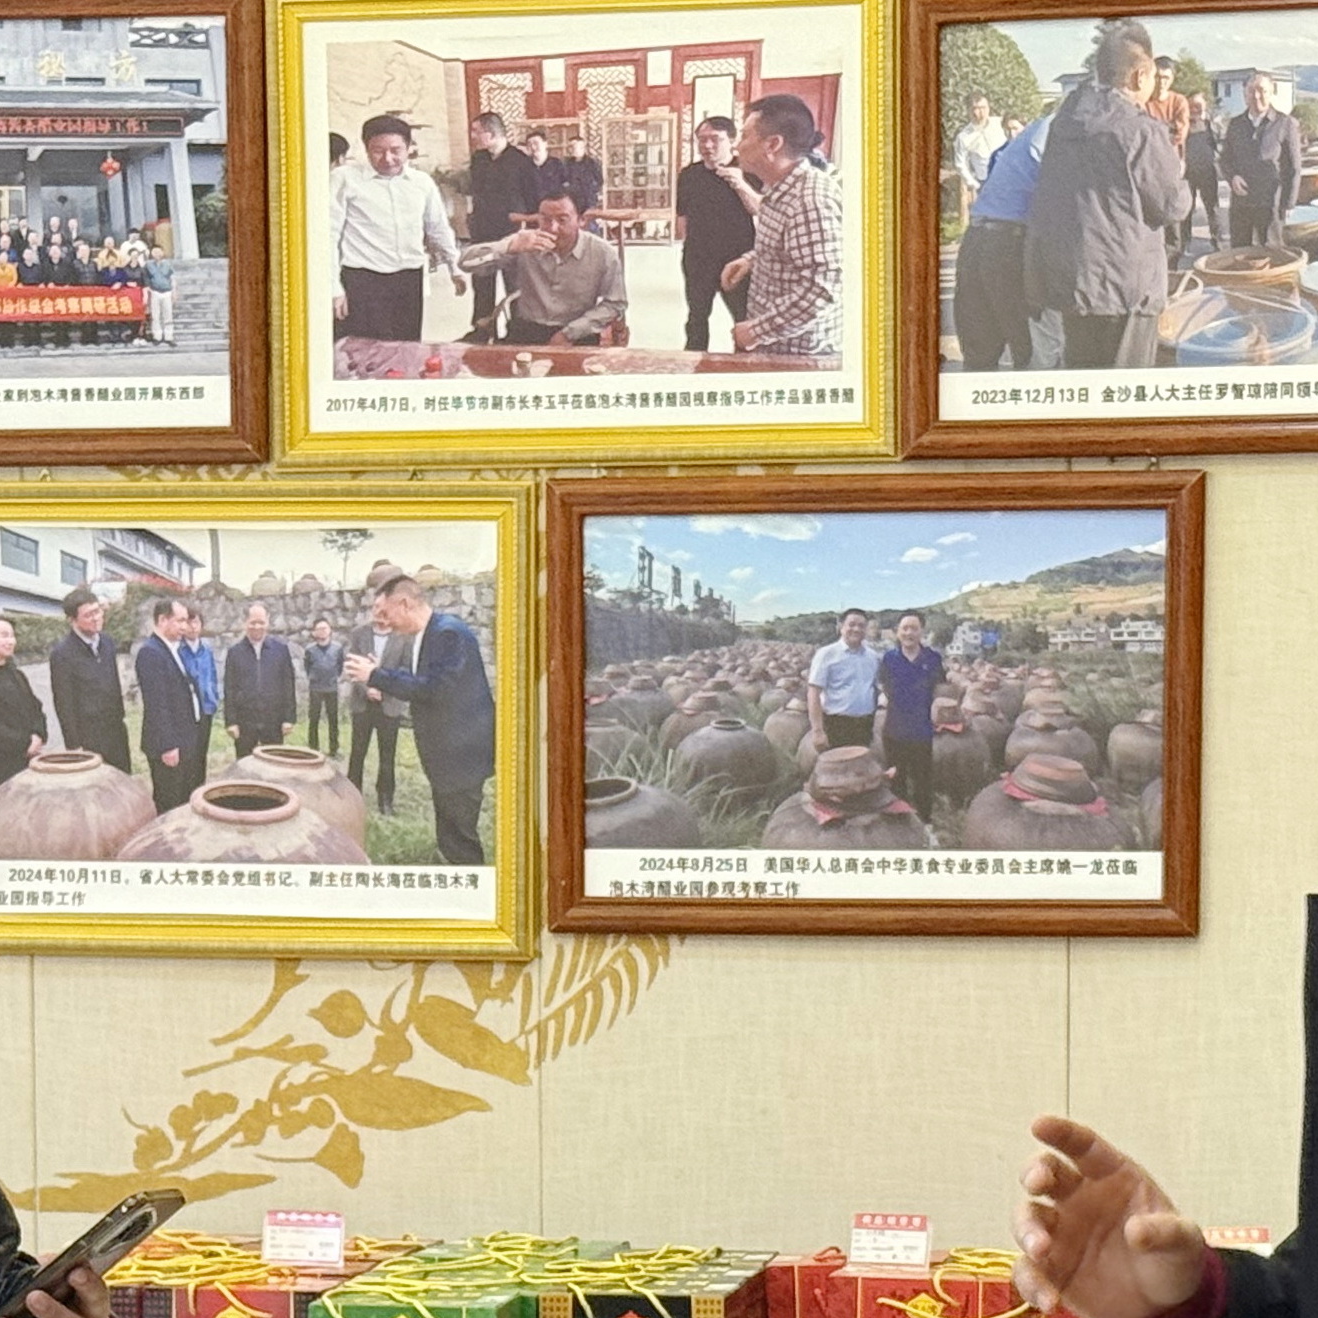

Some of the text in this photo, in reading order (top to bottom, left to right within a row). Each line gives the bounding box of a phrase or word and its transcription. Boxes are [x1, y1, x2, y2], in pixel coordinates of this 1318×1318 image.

[971, 386, 1090, 406] 2023年12月13日
[638, 856, 749, 874] 2024年8月25日
